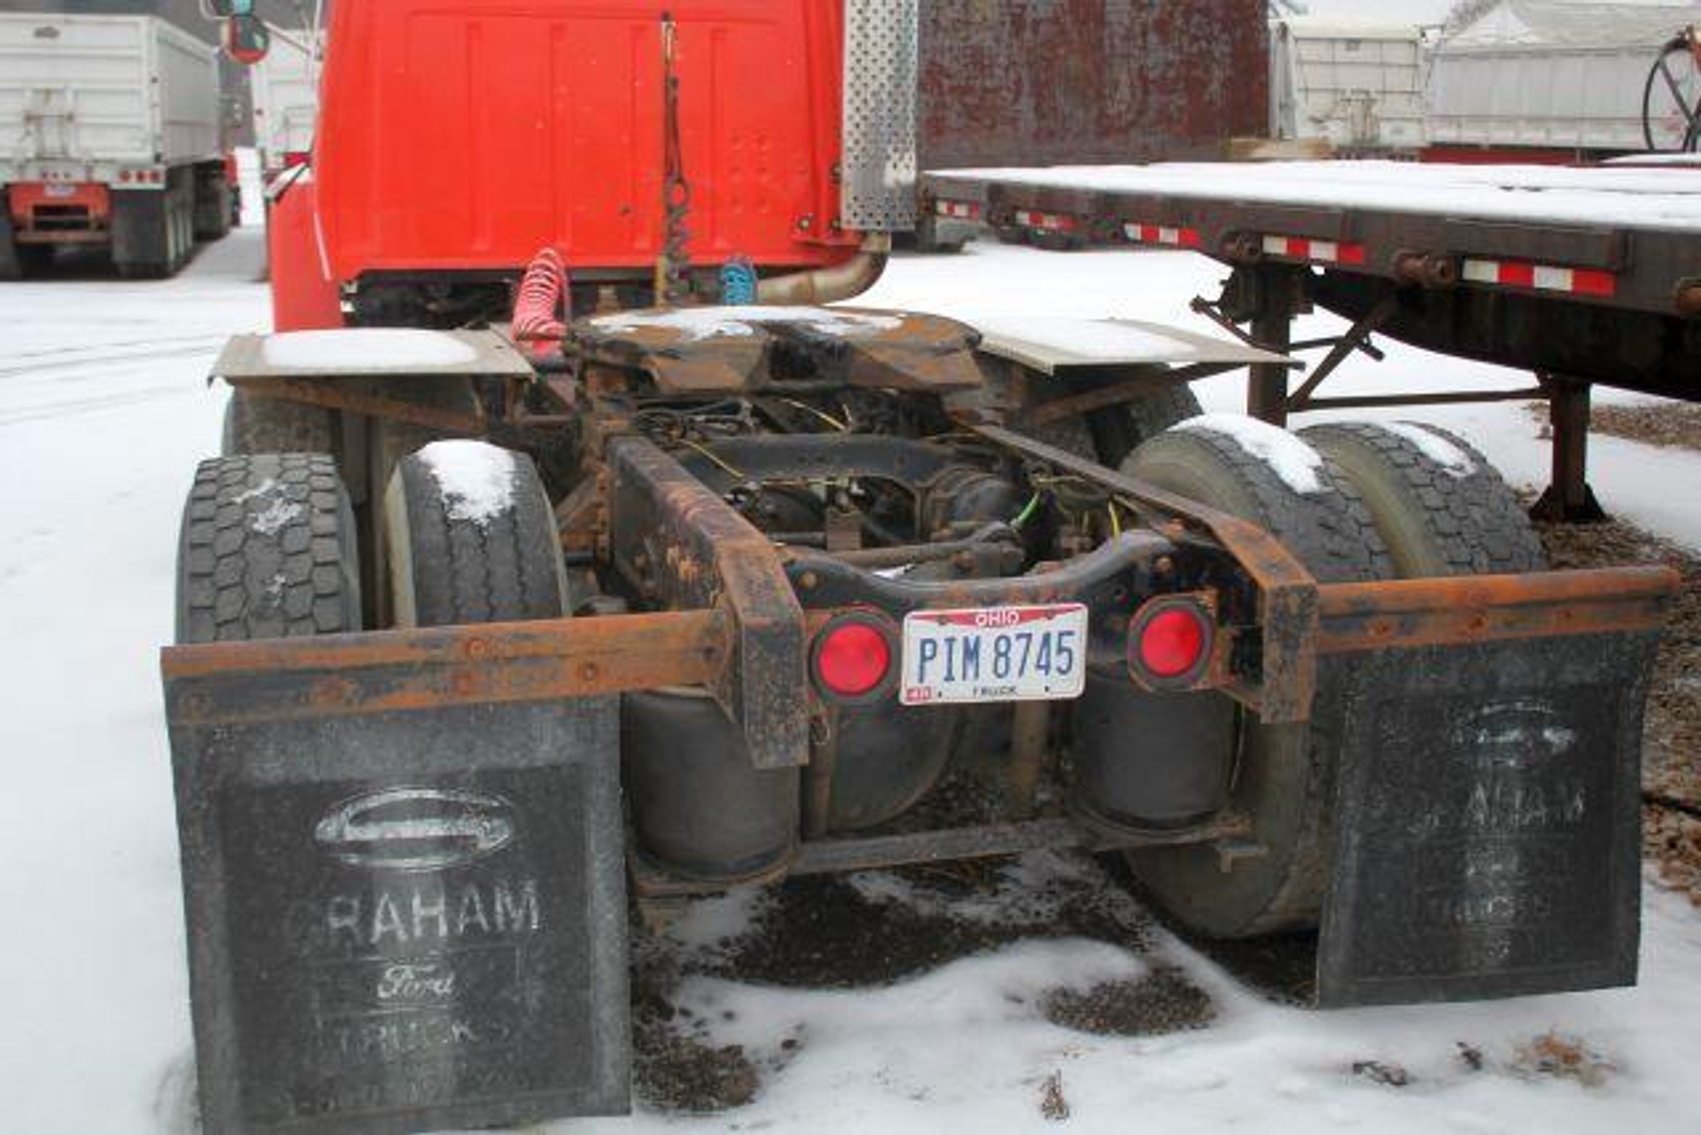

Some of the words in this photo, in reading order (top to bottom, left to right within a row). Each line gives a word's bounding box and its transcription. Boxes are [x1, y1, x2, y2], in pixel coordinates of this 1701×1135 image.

[975, 611, 1020, 627] OHIO
[918, 637, 980, 684] PIM
[993, 630, 1076, 680] 8745
[973, 685, 1018, 697] TRUCK
[377, 964, 456, 998] Ford
